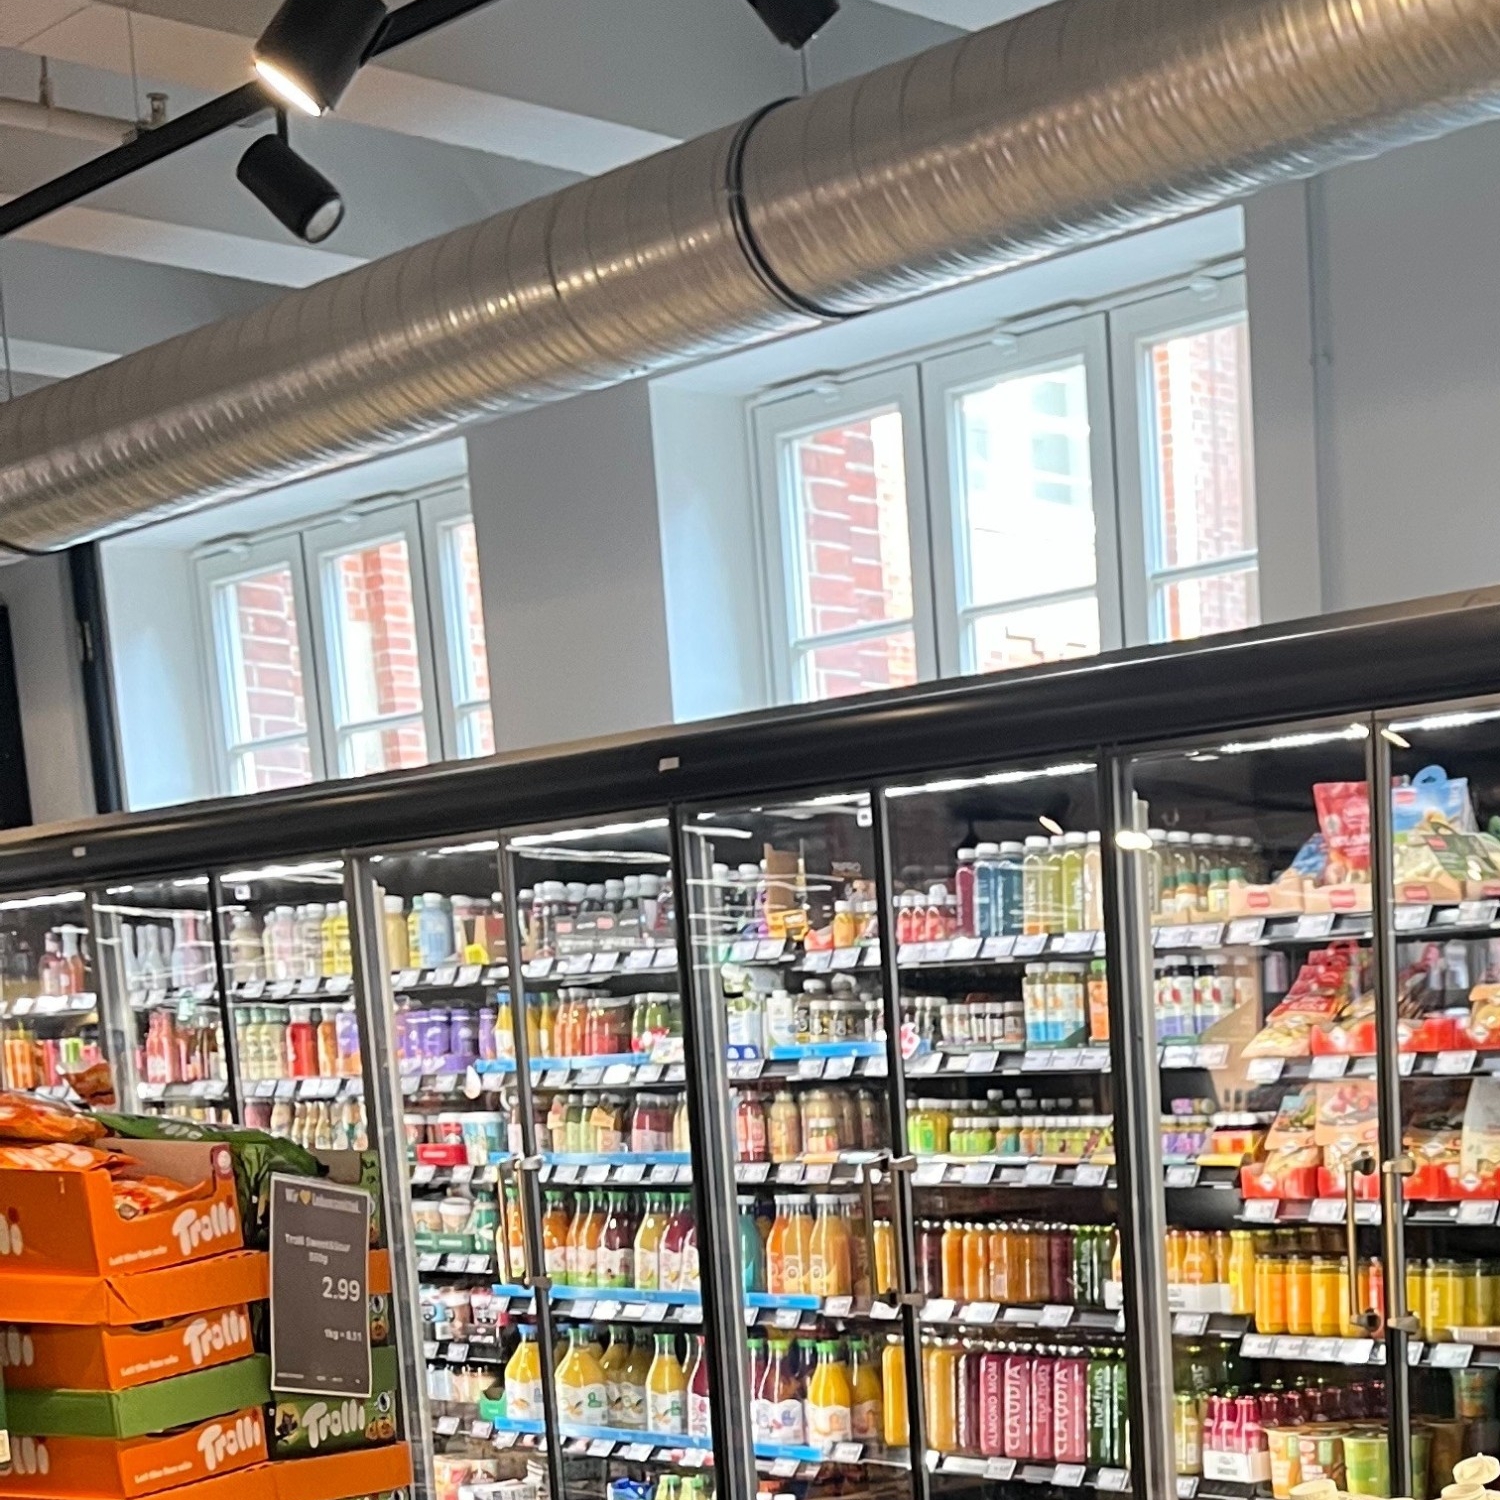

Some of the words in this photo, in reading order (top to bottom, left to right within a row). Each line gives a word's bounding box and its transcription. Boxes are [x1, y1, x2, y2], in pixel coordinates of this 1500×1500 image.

[172, 1201, 236, 1256] Trolli
[322, 1276, 360, 1302] 2.99
[183, 1309, 247, 1365] Trolli
[197, 1416, 261, 1471] Trolli
[302, 1400, 366, 1449] Trolli
